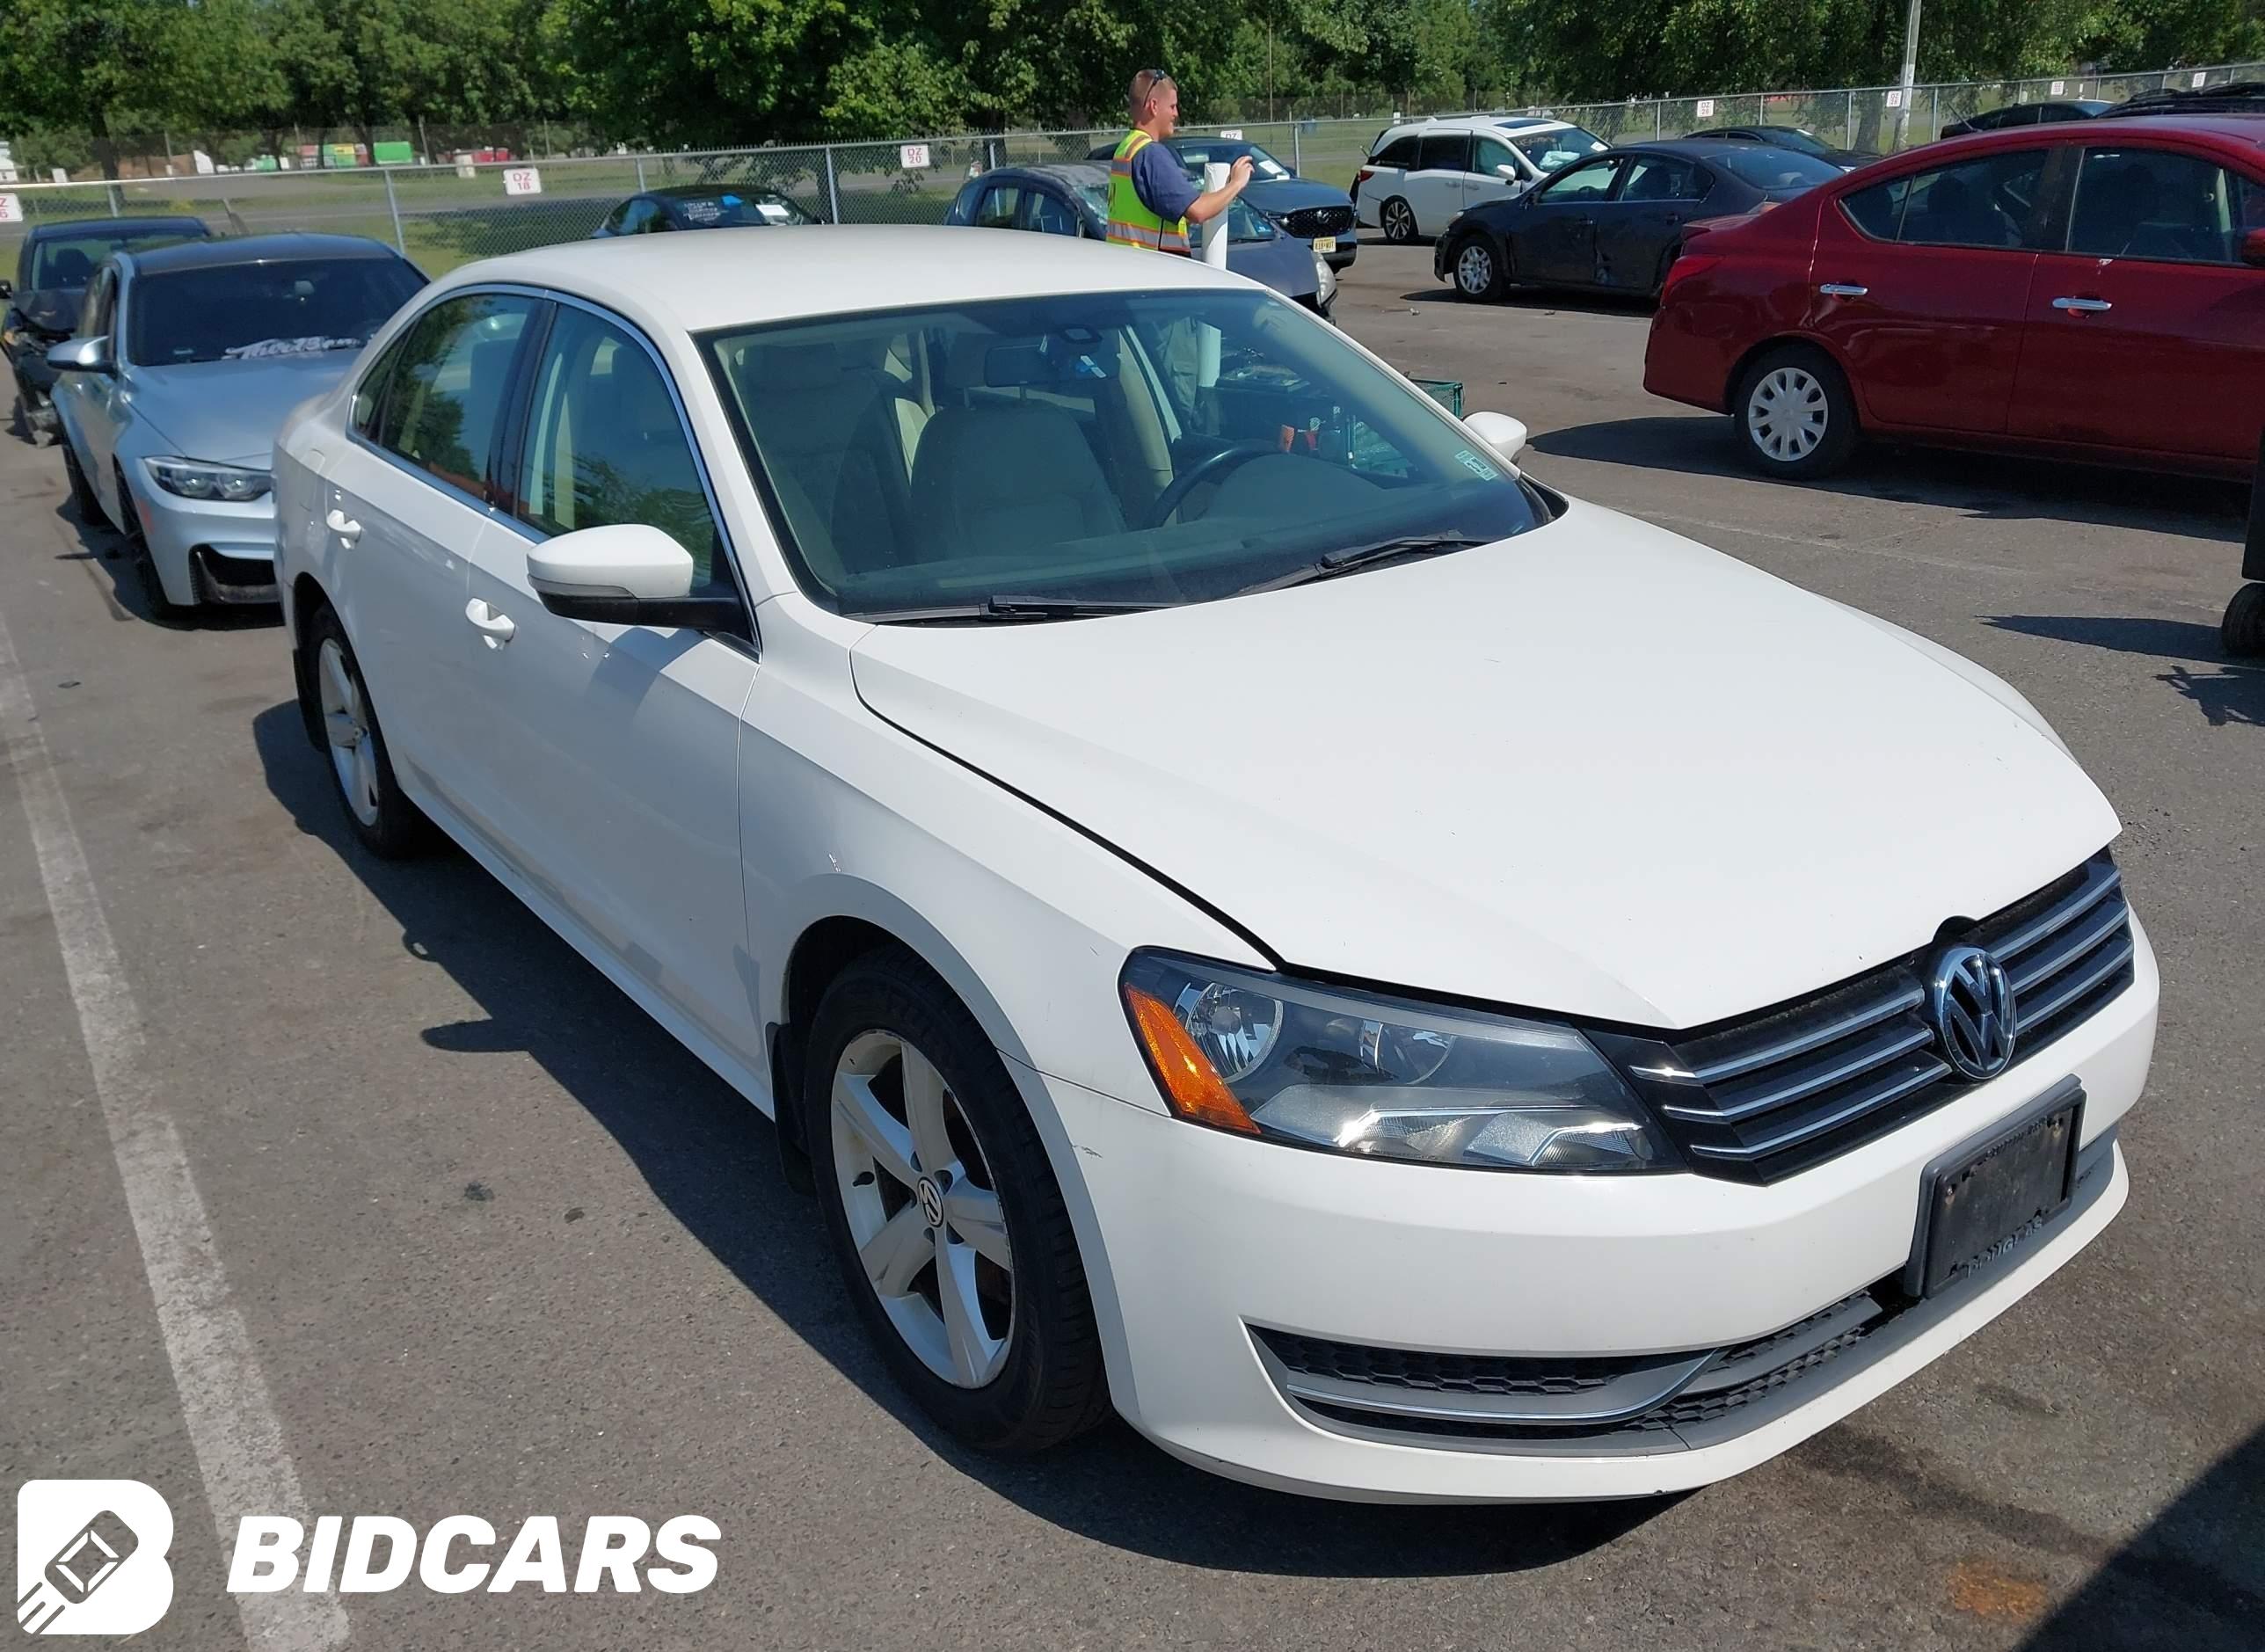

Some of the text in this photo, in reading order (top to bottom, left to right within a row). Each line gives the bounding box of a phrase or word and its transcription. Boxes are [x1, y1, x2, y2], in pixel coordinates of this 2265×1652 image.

[907, 147, 922, 156] DZ
[513, 171, 532, 182] DZ
[517, 182, 531, 191] 18
